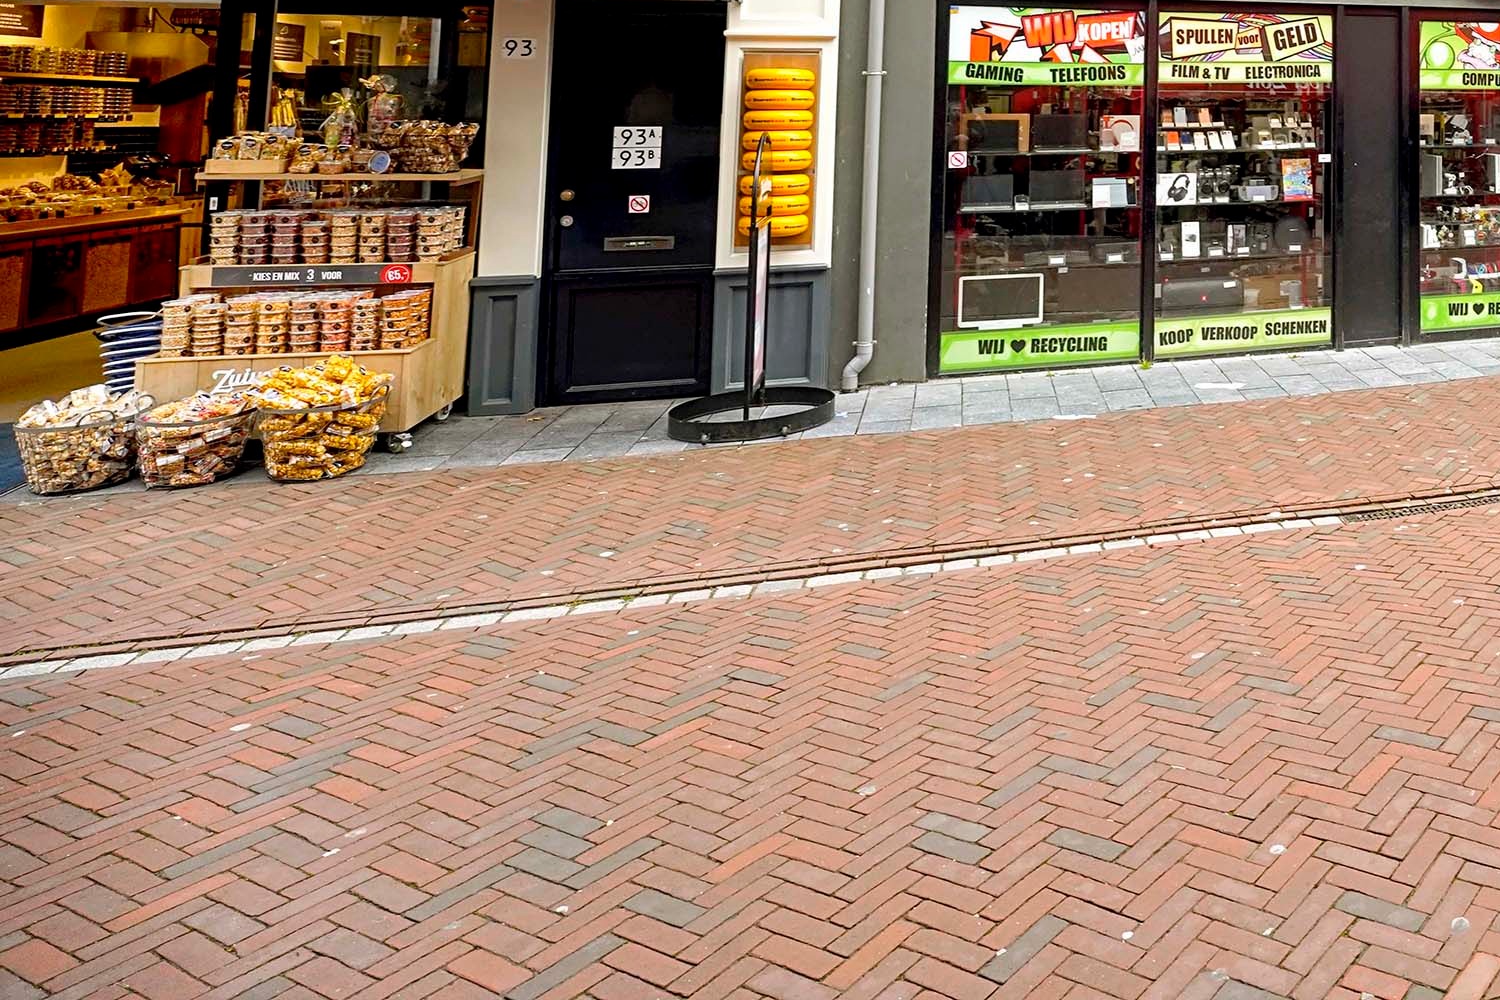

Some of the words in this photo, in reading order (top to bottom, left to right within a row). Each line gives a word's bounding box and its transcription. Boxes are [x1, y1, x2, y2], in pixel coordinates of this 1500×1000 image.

[1176, 29, 1233, 45] SPULLEN
[1273, 23, 1318, 51] GELD
[505, 40, 533, 56] 93
[965, 63, 1024, 83] GAMING
[1050, 66, 1126, 83] TELEFOONS
[1171, 65, 1199, 79] FILM
[1202, 68, 1211, 79] &
[1214, 67, 1230, 80] TV
[1245, 65, 1321, 80] ELECTRONICA
[253, 272, 271, 281] KIES
[271, 272, 284, 280] EN
[284, 271, 300, 280] MIX
[306, 269, 315, 280] 3
[321, 271, 342, 280] VOOR
[1448, 303, 1469, 316] WIJ
[1159, 328, 1194, 346] KOOP
[1201, 326, 1258, 341] VERKOOP
[1265, 320, 1327, 336] SCHENKEN
[978, 339, 1005, 354] WIJ
[1031, 337, 1108, 353] RECYCLING
